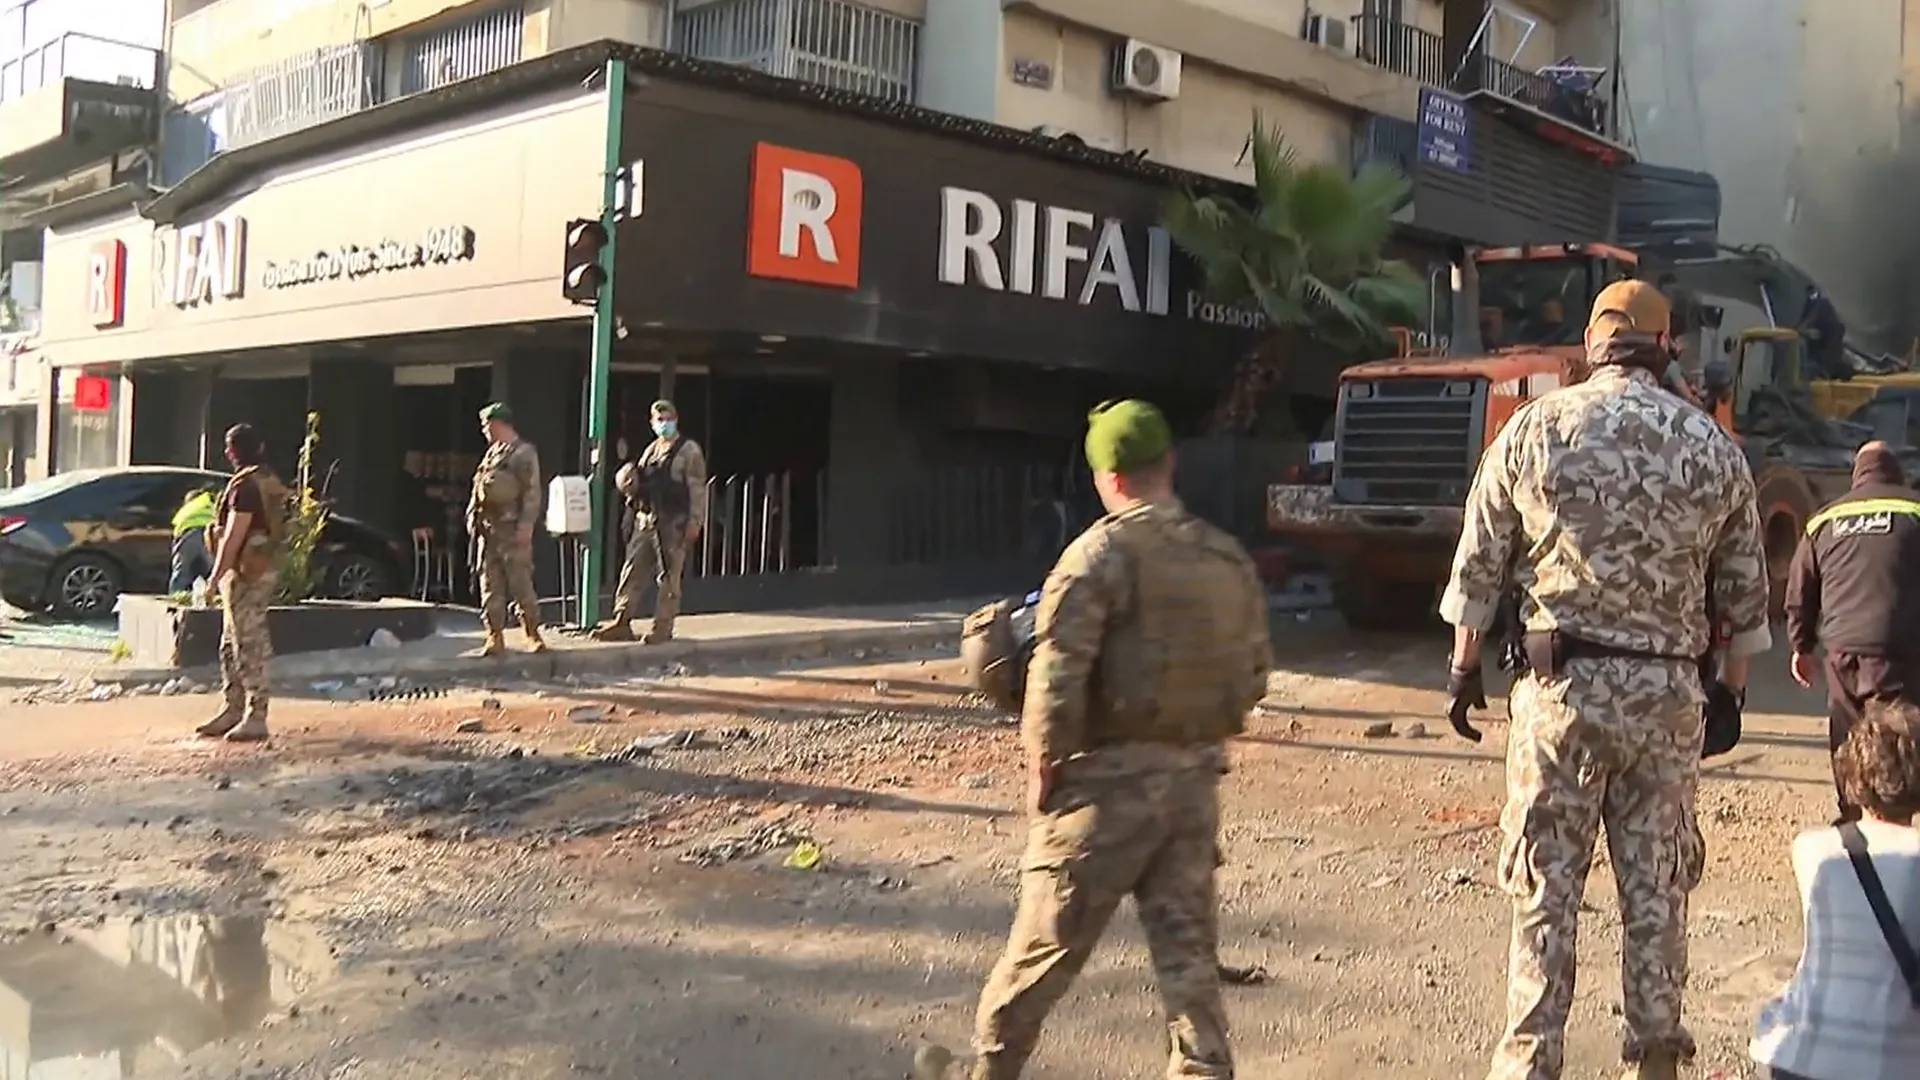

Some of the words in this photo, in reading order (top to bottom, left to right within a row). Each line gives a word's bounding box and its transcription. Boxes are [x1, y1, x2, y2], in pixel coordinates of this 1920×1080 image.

[424, 224, 475, 266] 1948
[778, 168, 840, 264] R
[938, 186, 1172, 317] RIFAI
[89, 252, 110, 314] R
[151, 216, 248, 310] RIFAI
[1187, 290, 1266, 332] Passion
